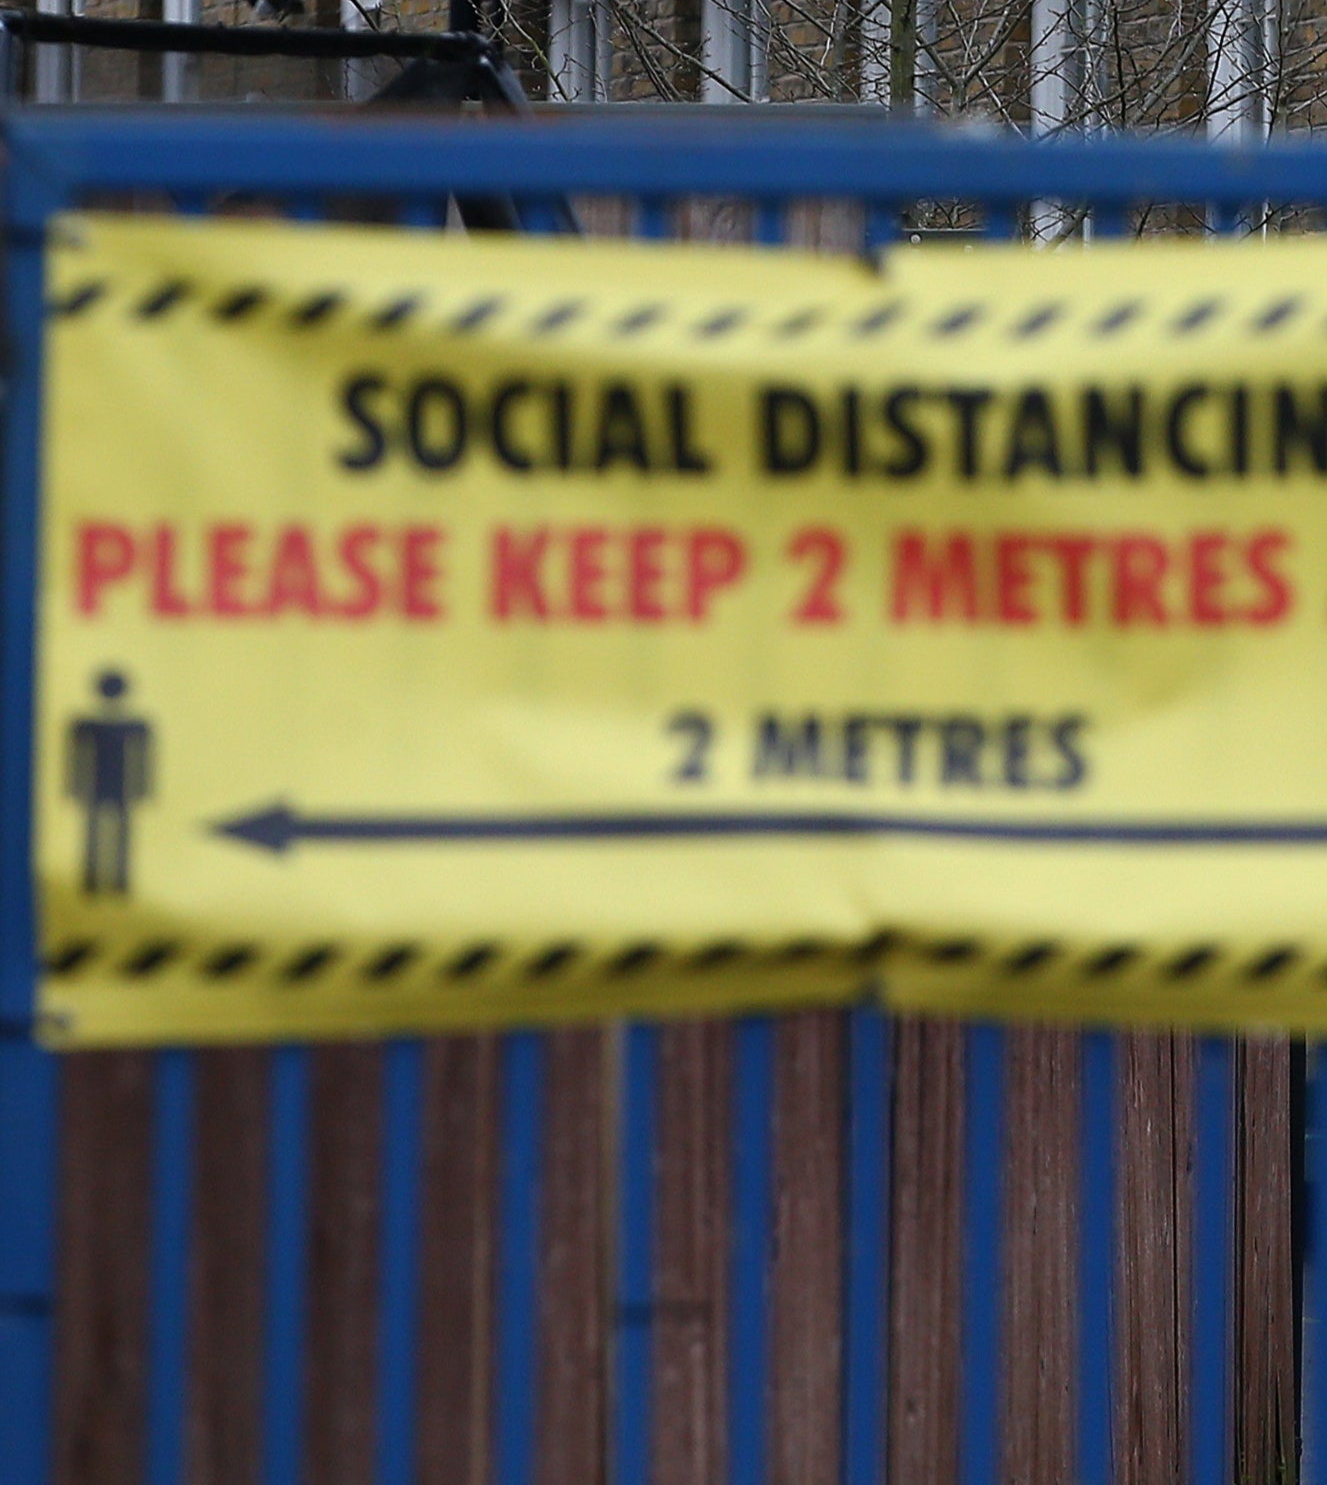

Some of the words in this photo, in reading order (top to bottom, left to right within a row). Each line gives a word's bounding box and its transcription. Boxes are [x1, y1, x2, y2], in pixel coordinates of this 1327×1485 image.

[338, 372, 710, 476] SOCIAL
[72, 522, 446, 622] PLEASE
[489, 524, 749, 624] KEEP
[787, 524, 844, 624] 2
[890, 526, 1293, 626] METRES
[665, 712, 714, 785] 2
[752, 713, 1091, 791] METRES
